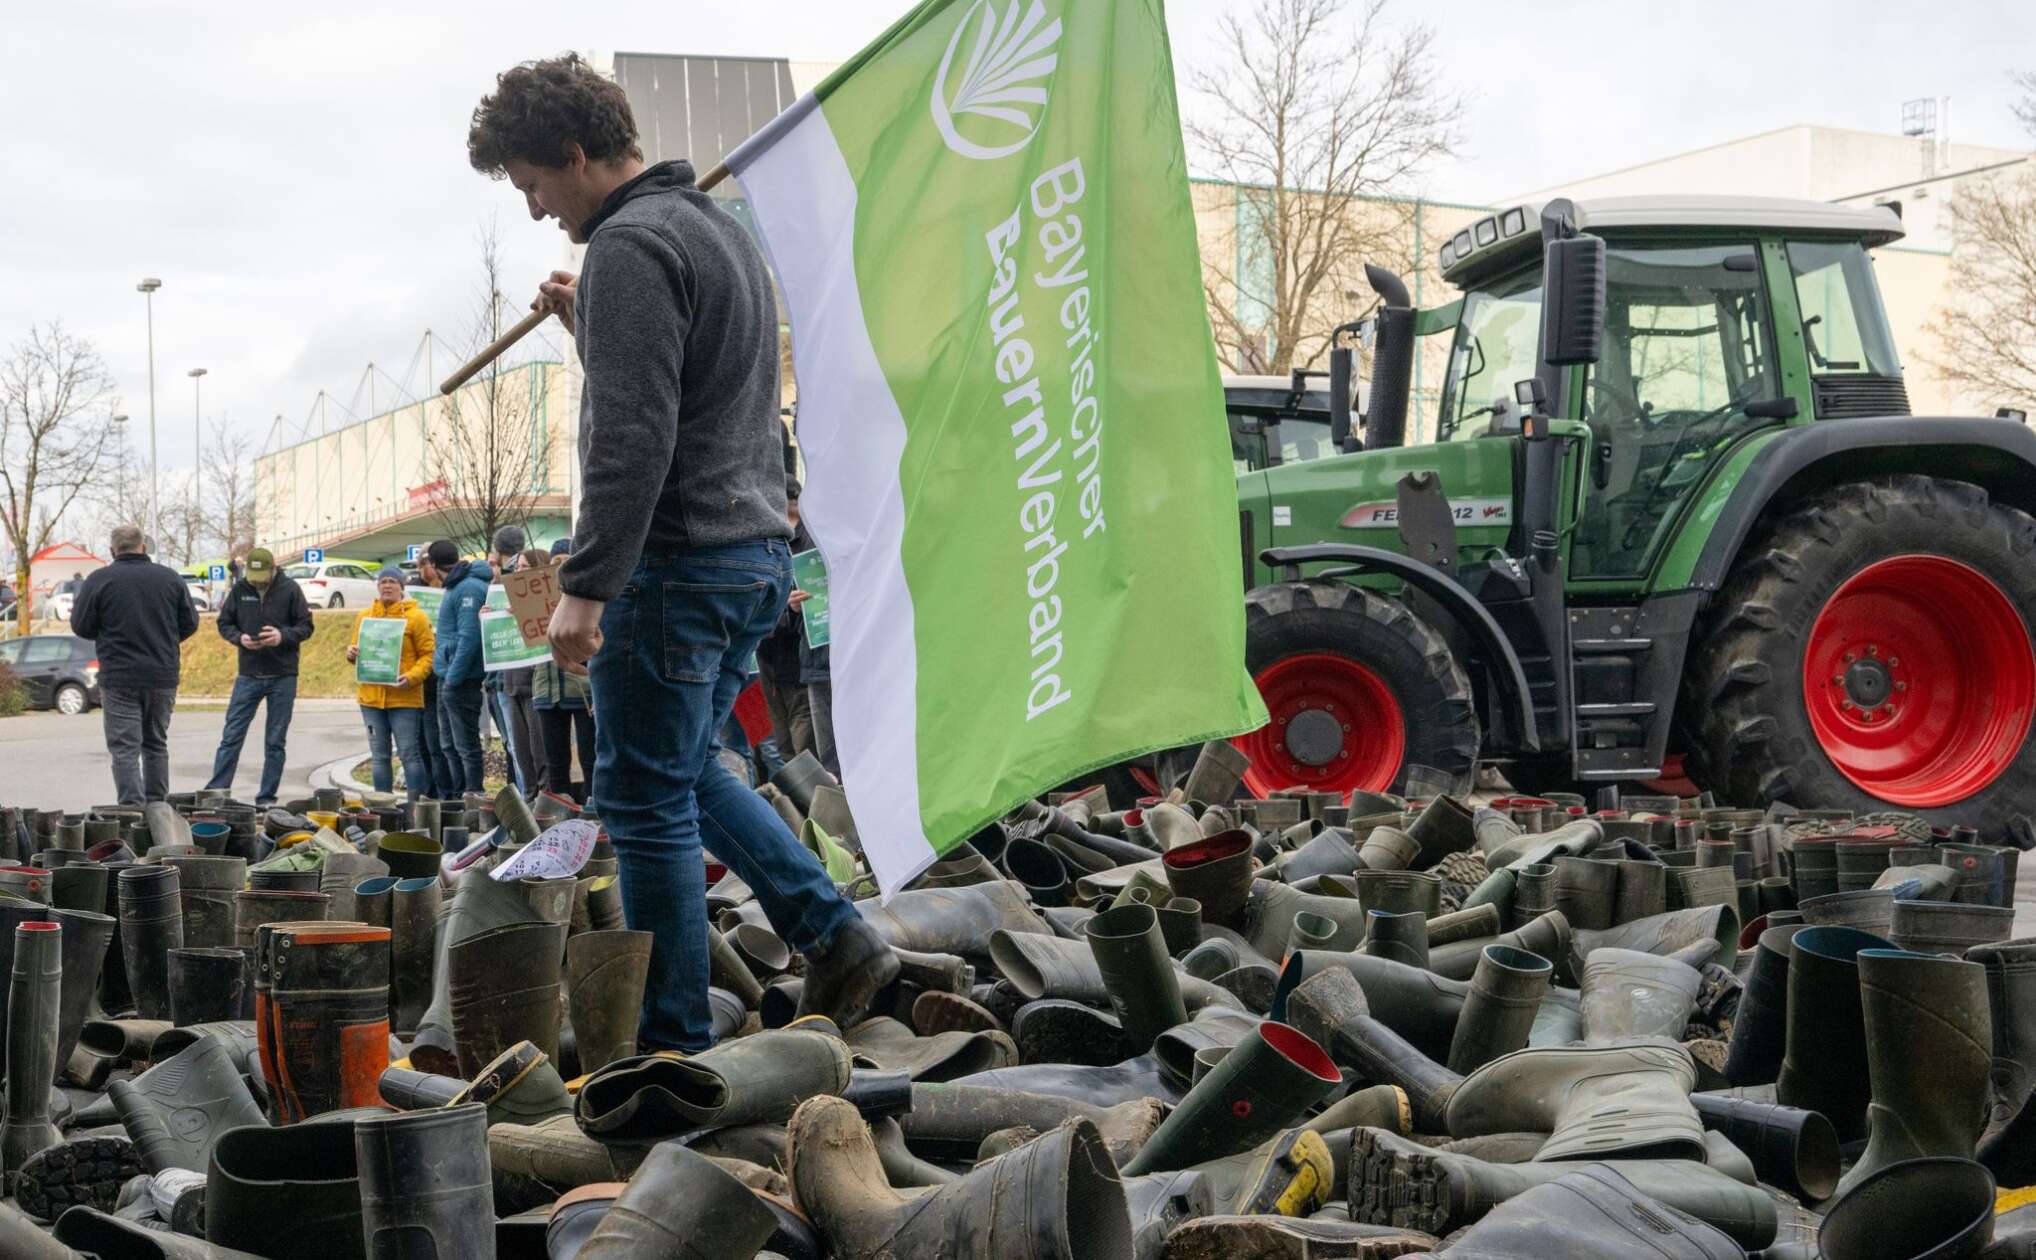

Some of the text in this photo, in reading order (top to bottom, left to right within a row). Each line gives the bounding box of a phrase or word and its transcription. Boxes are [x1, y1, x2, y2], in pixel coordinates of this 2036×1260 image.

[1030, 157, 1106, 539] Bayerischer
[1372, 509, 1399, 521] FE
[1453, 507, 1473, 518] 12
[308, 550, 319, 563] P
[212, 566, 222, 579] P
[523, 617, 549, 640] GE
